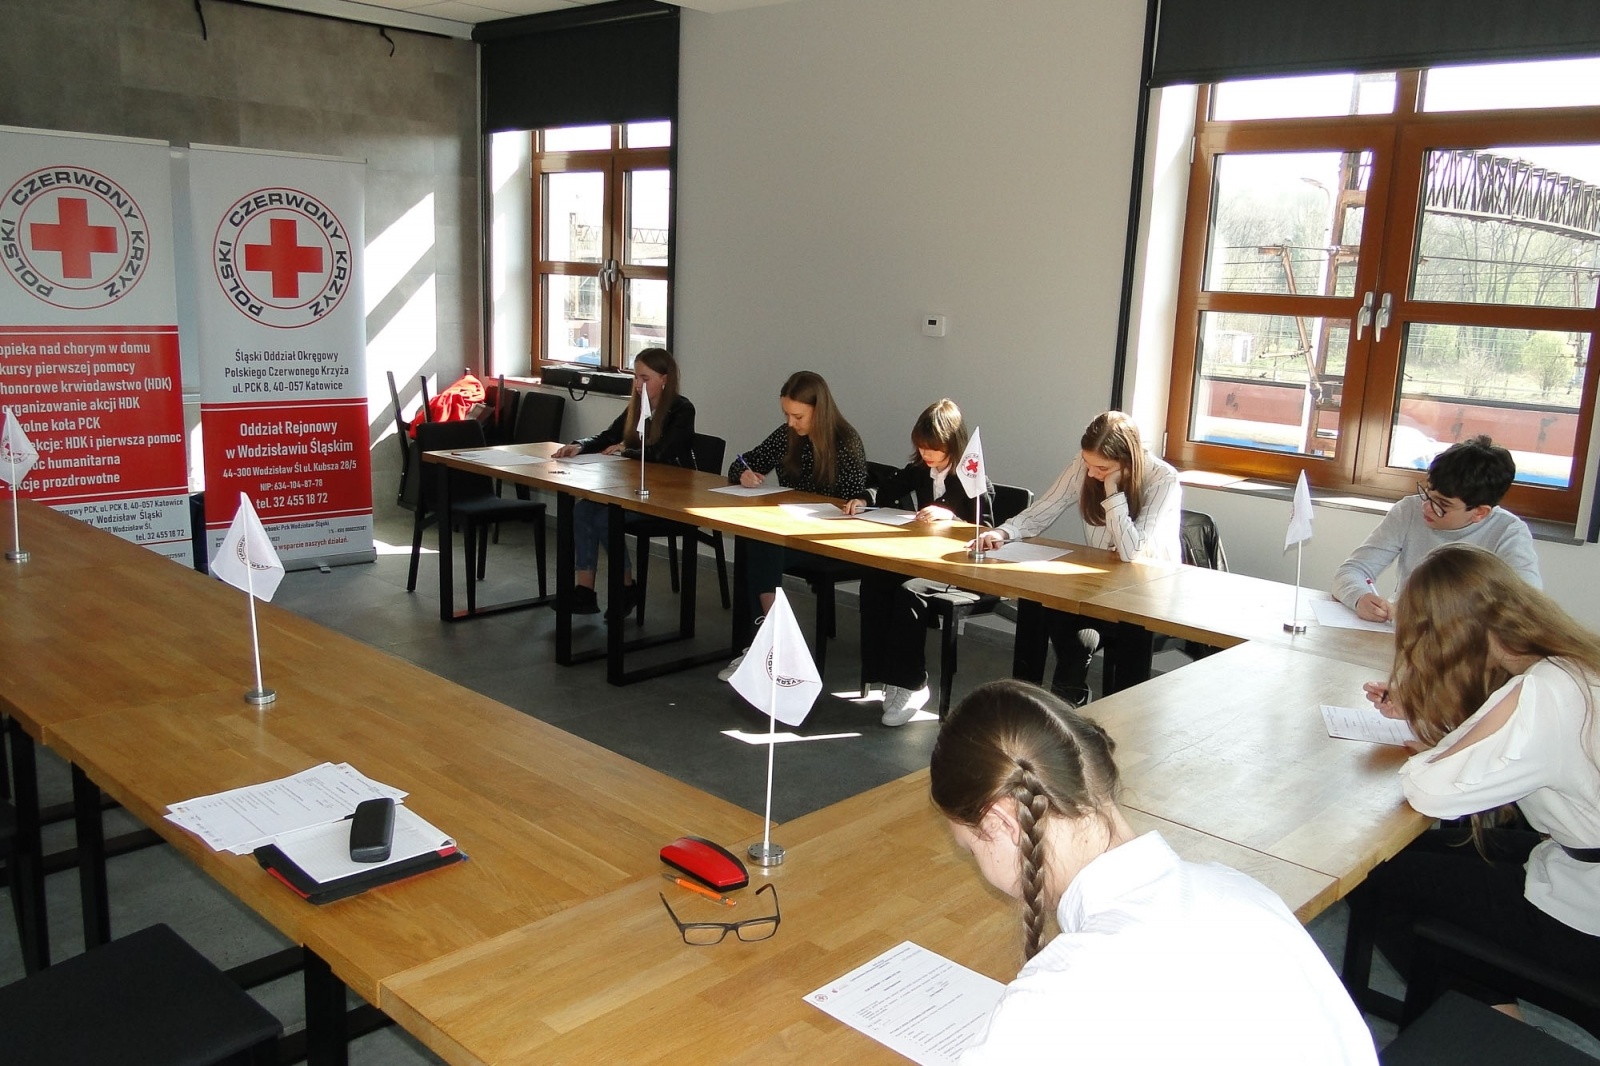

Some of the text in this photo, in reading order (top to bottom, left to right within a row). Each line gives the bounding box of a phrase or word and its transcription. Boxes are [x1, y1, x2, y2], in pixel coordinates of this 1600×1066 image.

[1, 171, 145, 298] POLSKI CZERWONY KRZYŻ
[219, 193, 348, 317] POLSKI CZERWONY KRZYŻ
[39, 342, 61, 355] nad
[63, 342, 106, 358] chorym
[108, 345, 118, 354] w
[120, 341, 151, 354] domu
[235, 349, 339, 363] Śląski Oddział Okręgowy
[0, 361, 136, 378] kursy pierwszej pomocy
[225, 365, 349, 379] Polskiego Czerwonego Krzyża
[0, 377, 172, 395] honorowe krwiodawstwo (HDK)
[245, 382, 262, 393] PCK
[273, 381, 304, 392] 40-057
[305, 380, 343, 391] Katowice
[2, 396, 140, 417] organizowanie akcji HDK
[51, 418, 76, 432] koła
[78, 417, 101, 430] PCK
[240, 420, 338, 437] Oddział Rejonowy
[31, 433, 182, 453] ekcje: HDK i pierwsza pomoc
[225, 437, 353, 459] w Wodzisławiu Śląskim
[47, 455, 121, 470] humanitarna
[223, 467, 251, 478] 44-300
[252, 465, 293, 476] Wodzisław
[313, 462, 339, 472] Kubsza
[340, 459, 357, 471] 28/5
[42, 472, 121, 491] prozdrowotne
[260, 482, 274, 491] NIP:
[109, 503, 123, 511] PCK
[130, 501, 154, 509] 40-057
[154, 499, 184, 507] Katowice
[256, 492, 328, 509] tel. 32 455 18 72
[96, 512, 137, 524] Wodzisław
[139, 509, 163, 521] Śląski
[112, 524, 144, 533] Wodzisław
[147, 532, 156, 540] 32
[156, 531, 168, 539] 455
[169, 530, 176, 538] 18
[177, 529, 185, 537] 72
[279, 542, 304, 551] wsparcie
[305, 540, 327, 548] naszych
